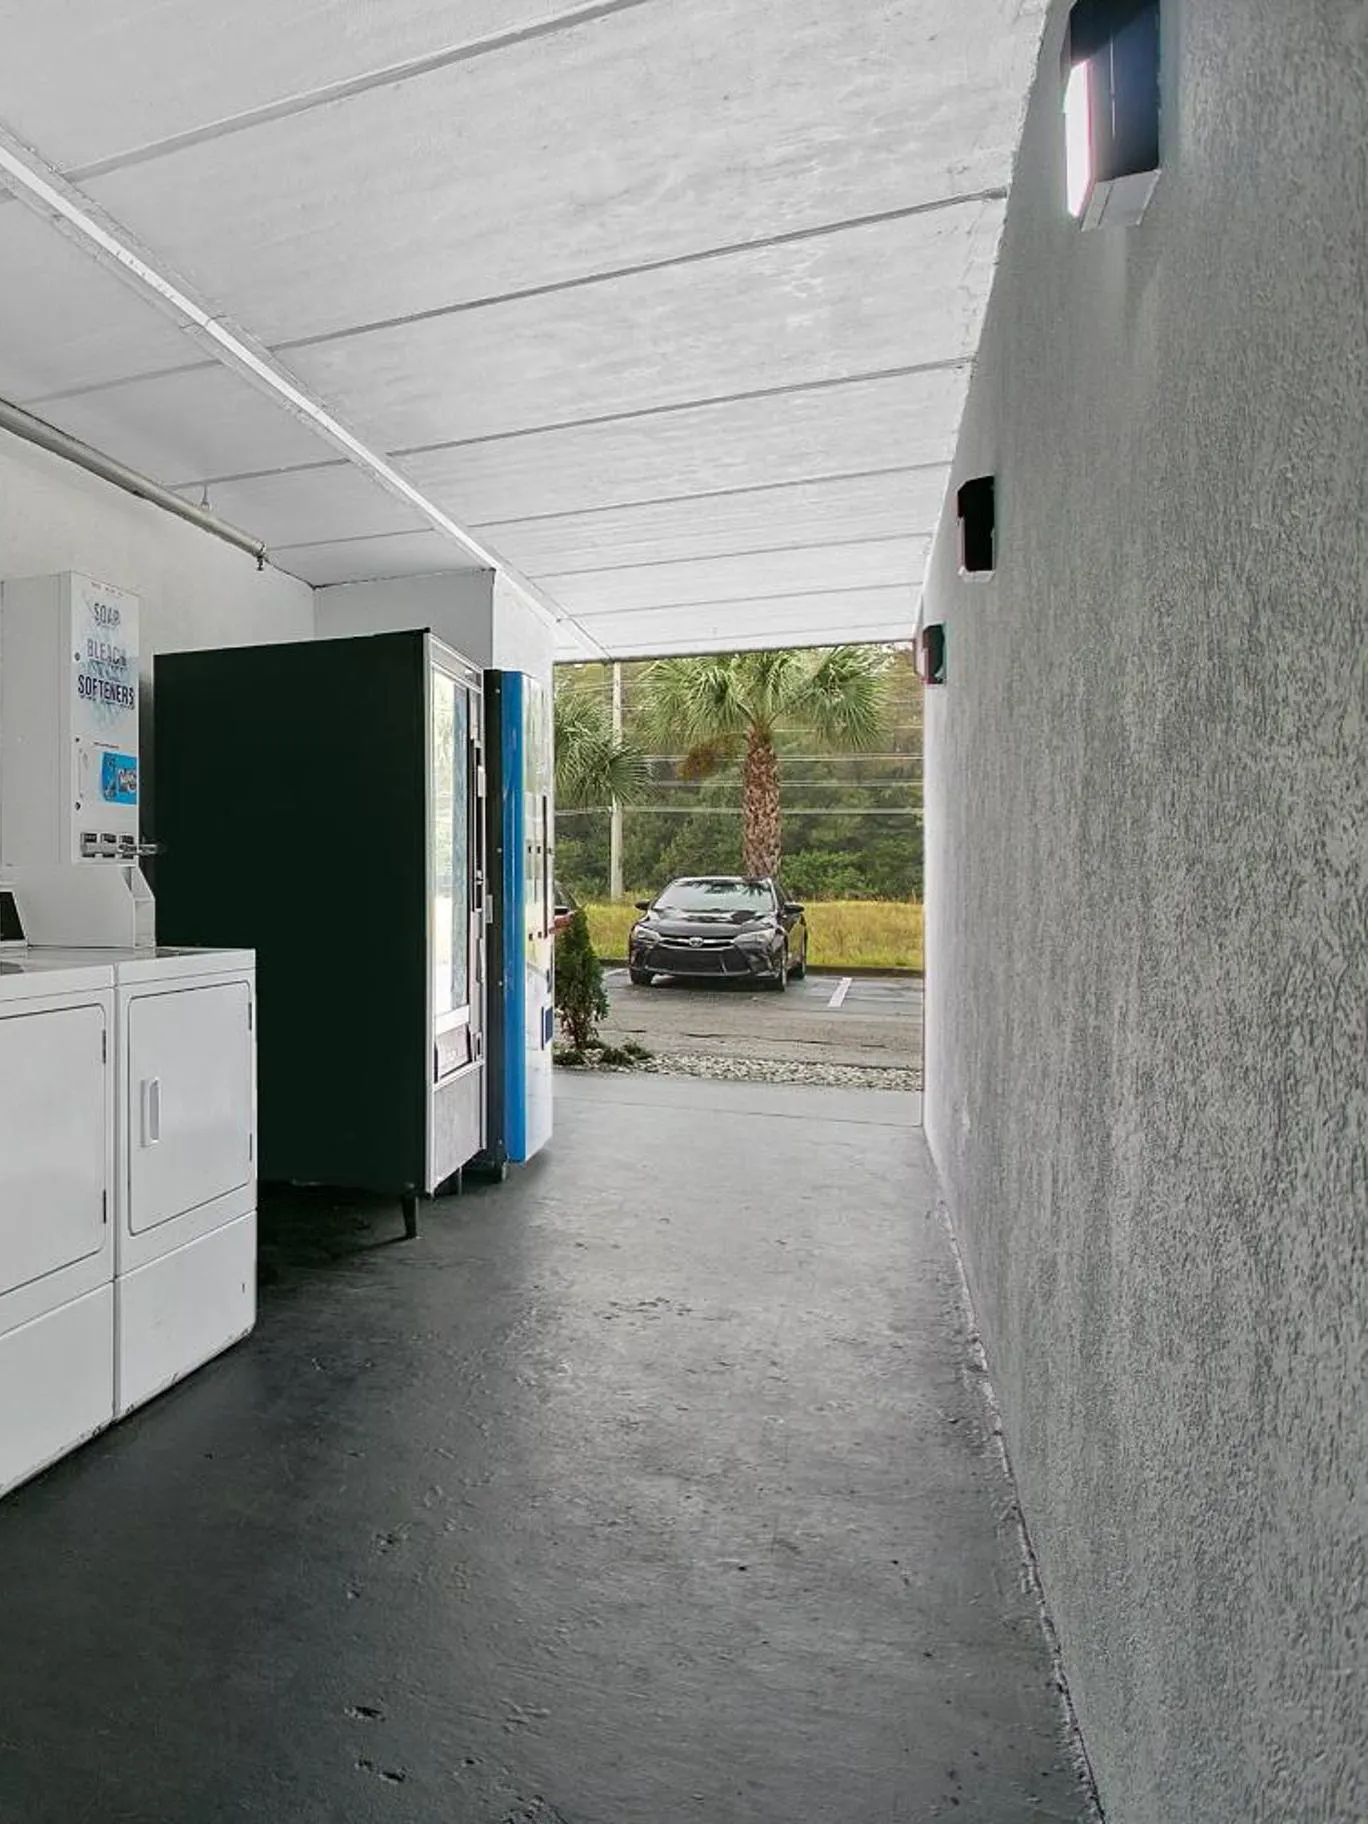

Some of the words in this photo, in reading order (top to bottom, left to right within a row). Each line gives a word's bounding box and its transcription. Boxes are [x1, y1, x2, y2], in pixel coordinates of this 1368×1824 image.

[94, 602, 121, 627] SOAP
[87, 637, 128, 669] BLEACH
[77, 674, 135, 707] SOFTENERS
